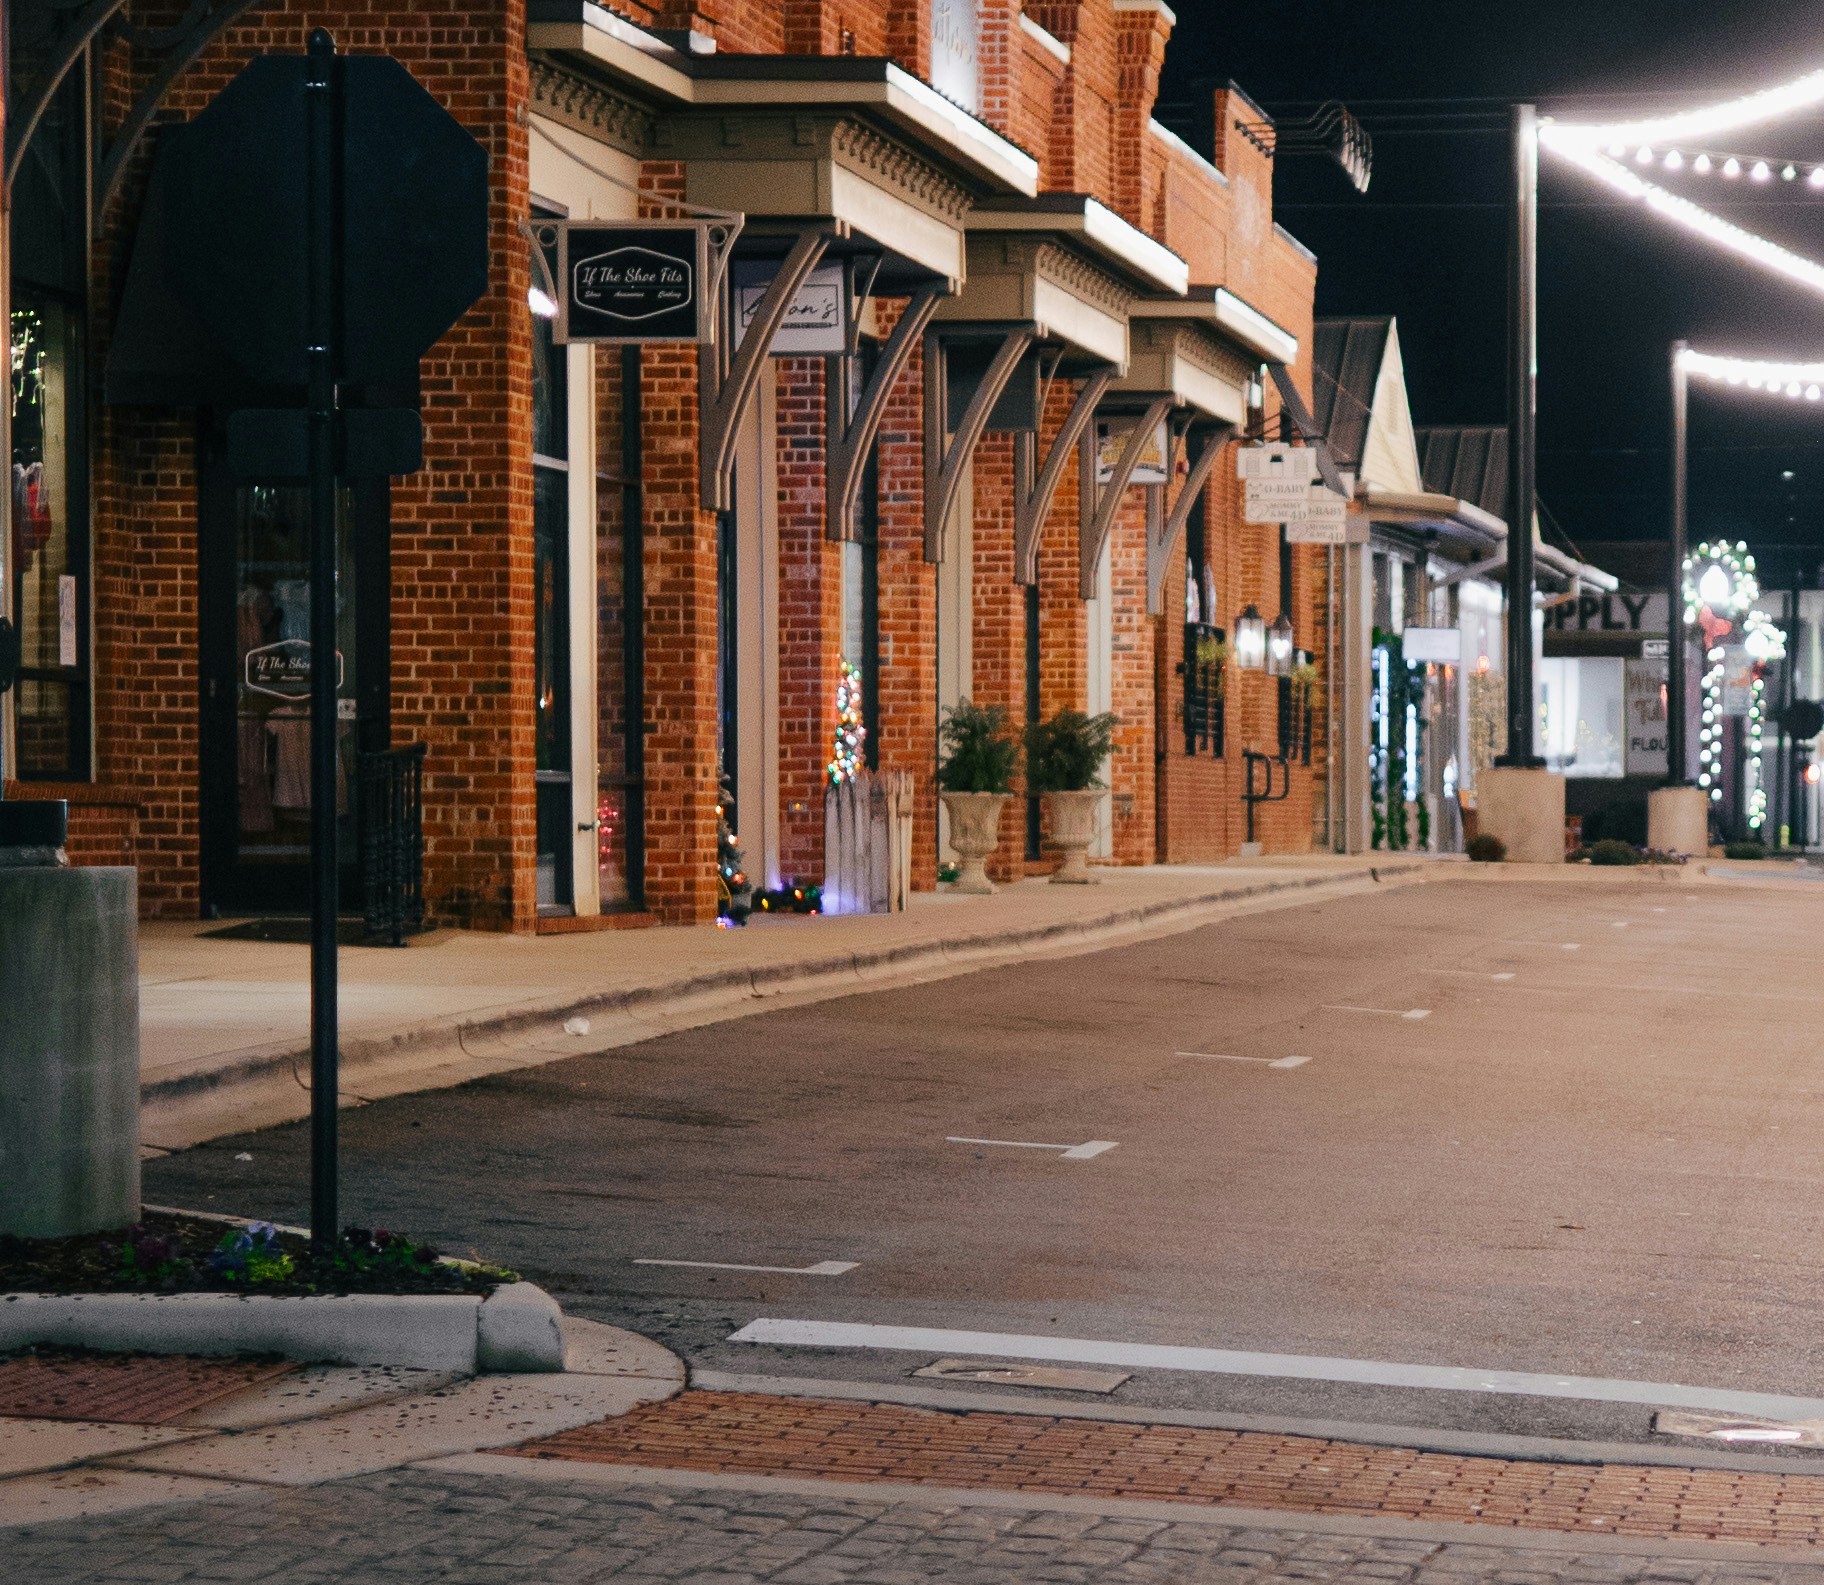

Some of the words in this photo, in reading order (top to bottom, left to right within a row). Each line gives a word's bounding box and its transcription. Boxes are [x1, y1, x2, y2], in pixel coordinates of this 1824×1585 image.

[582, 266, 598, 286] If
[600, 266, 621, 282] The
[624, 267, 656, 283] Shoe
[660, 267, 683, 283] Fits
[257, 656, 268, 671] If
[270, 656, 285, 669] The
[1631, 736, 1669, 752] FLOU
